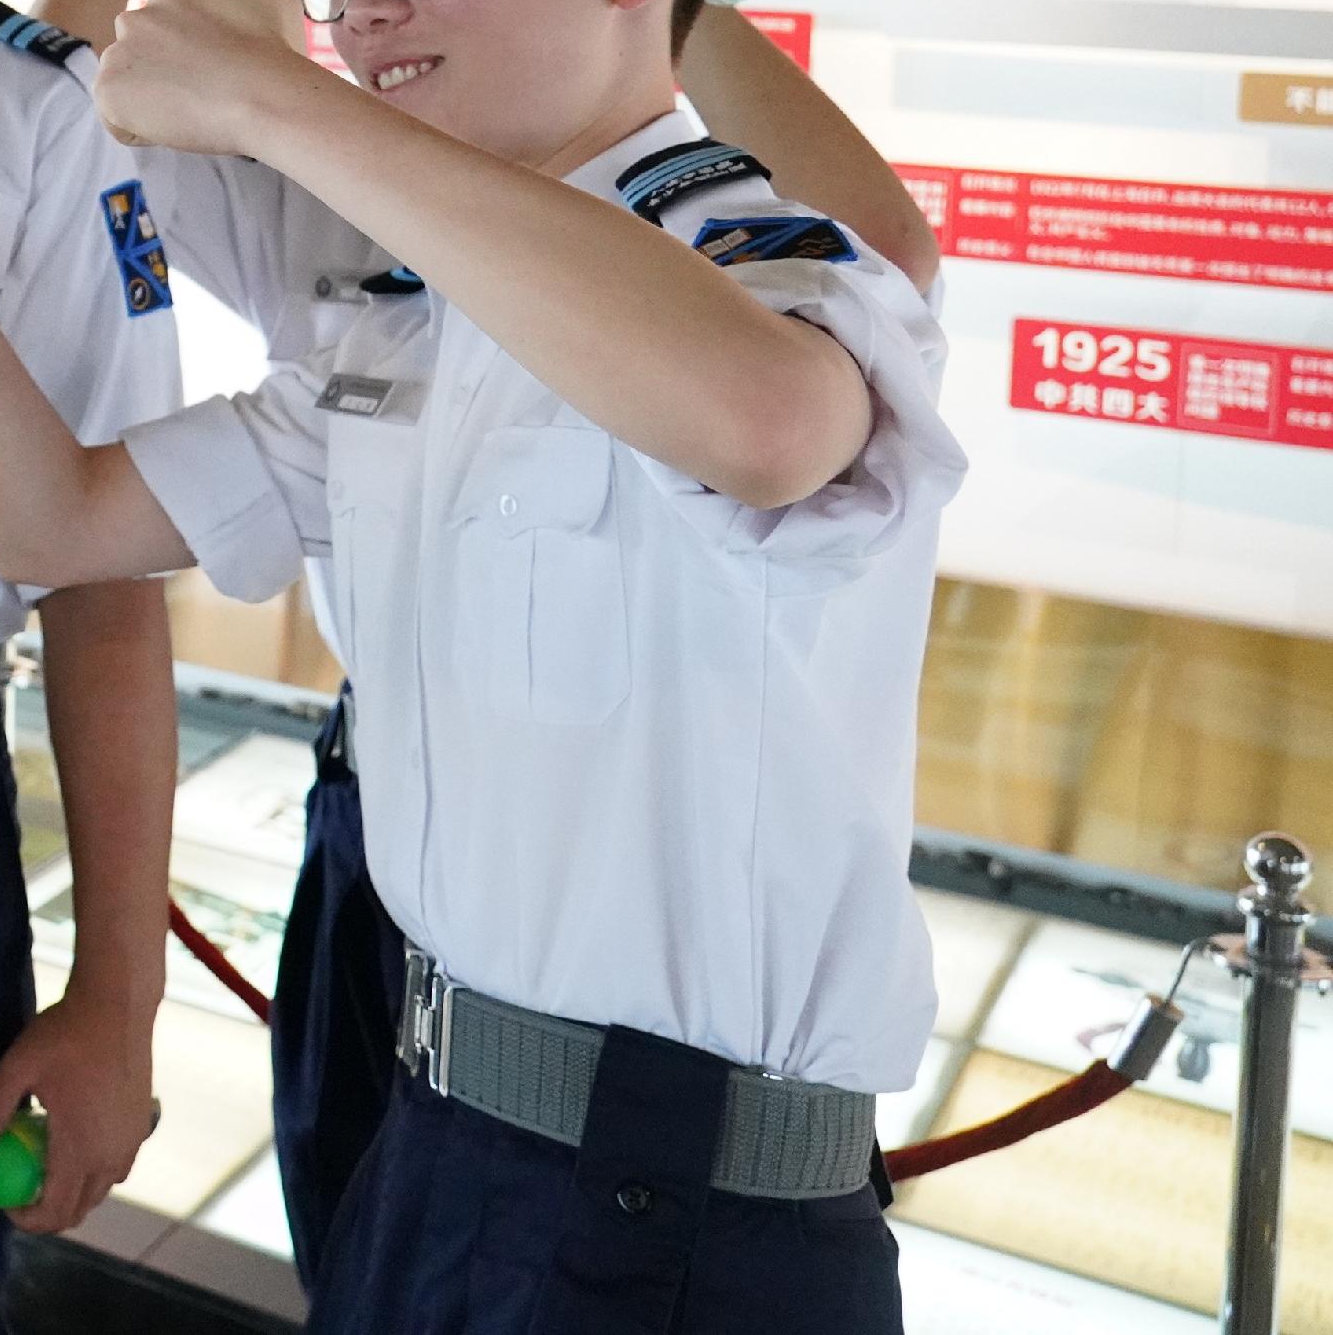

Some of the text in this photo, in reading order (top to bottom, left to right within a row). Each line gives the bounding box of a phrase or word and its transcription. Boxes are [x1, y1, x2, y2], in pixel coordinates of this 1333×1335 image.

[1033, 327, 1171, 382] 1925
[1034, 379, 1170, 423] 中共四大
